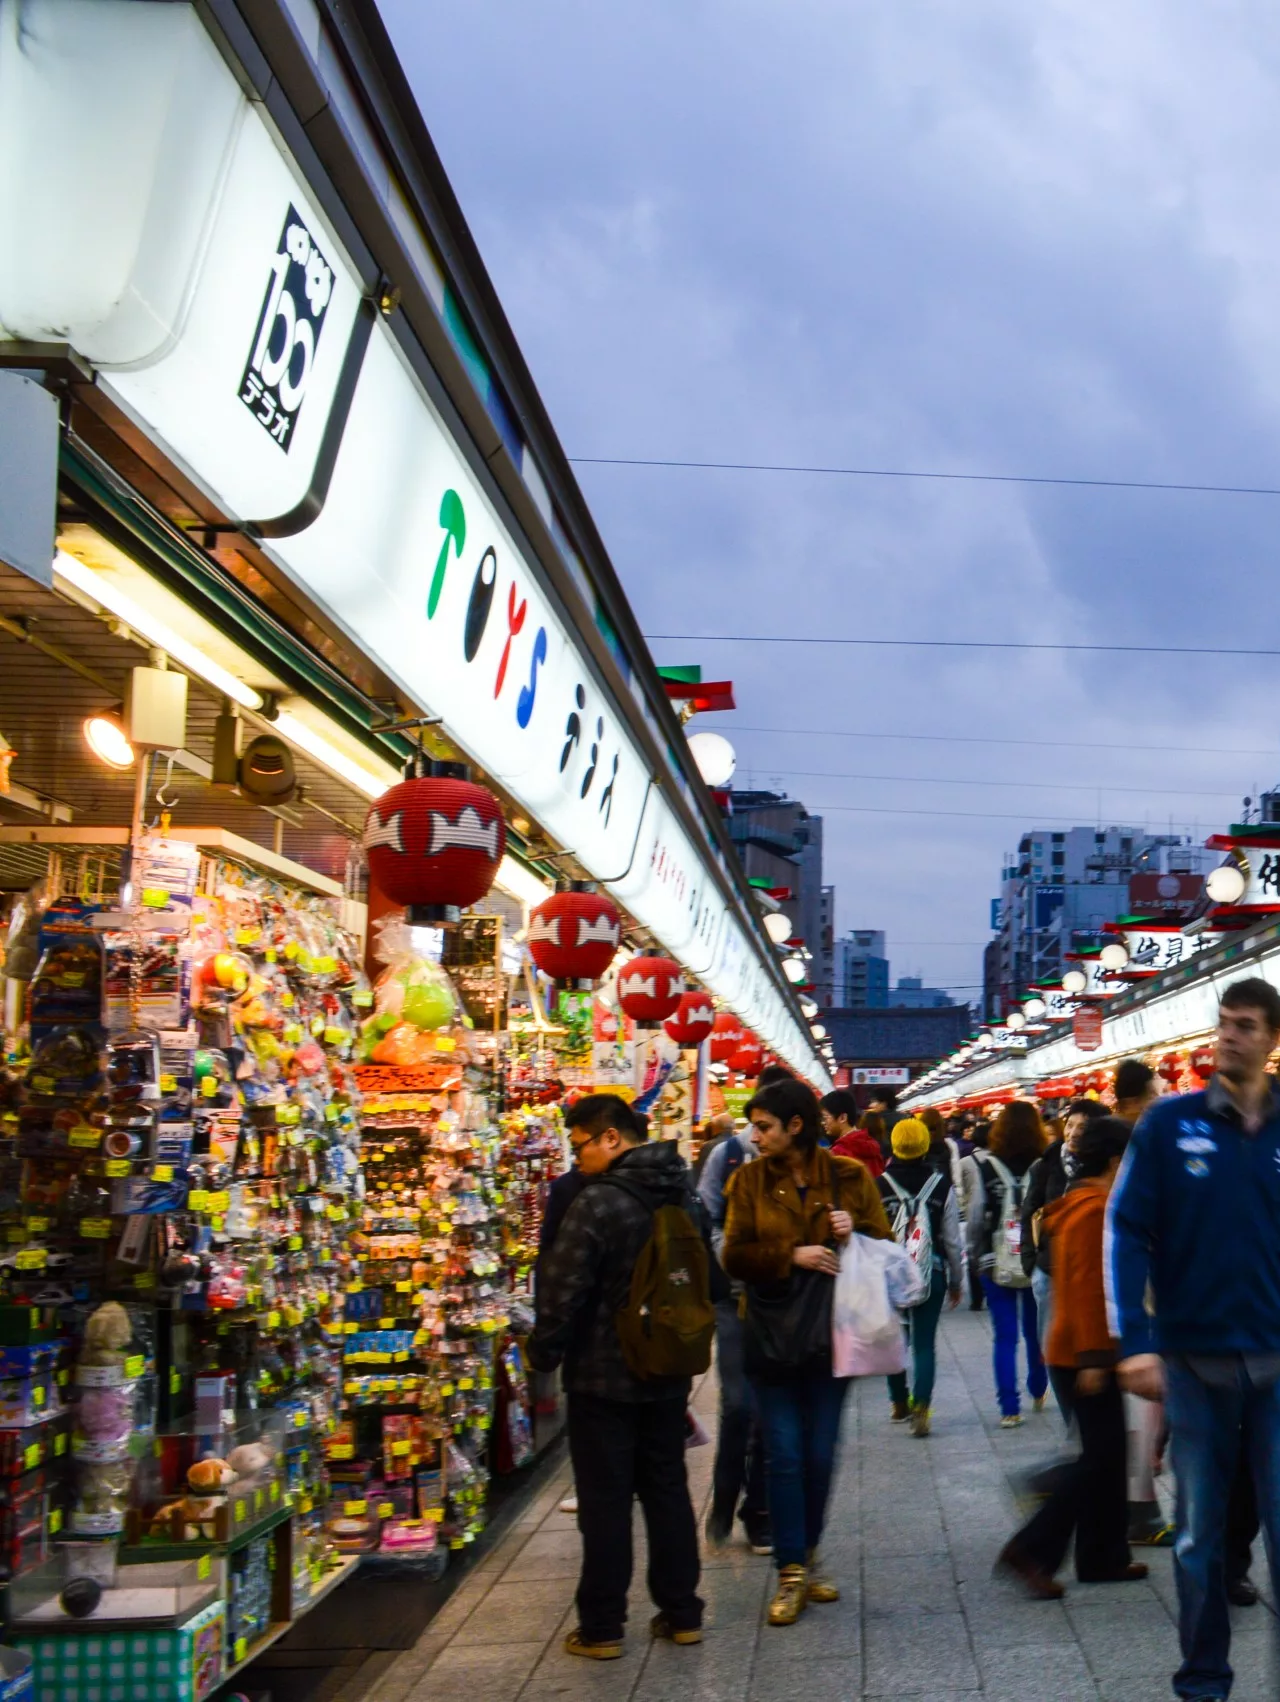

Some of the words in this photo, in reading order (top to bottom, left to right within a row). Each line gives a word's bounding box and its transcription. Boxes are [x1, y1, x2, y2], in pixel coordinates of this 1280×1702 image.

[242, 372, 290, 443] テラオ
[427, 488, 547, 729] TOYS
[560, 683, 621, 829] テラオ
